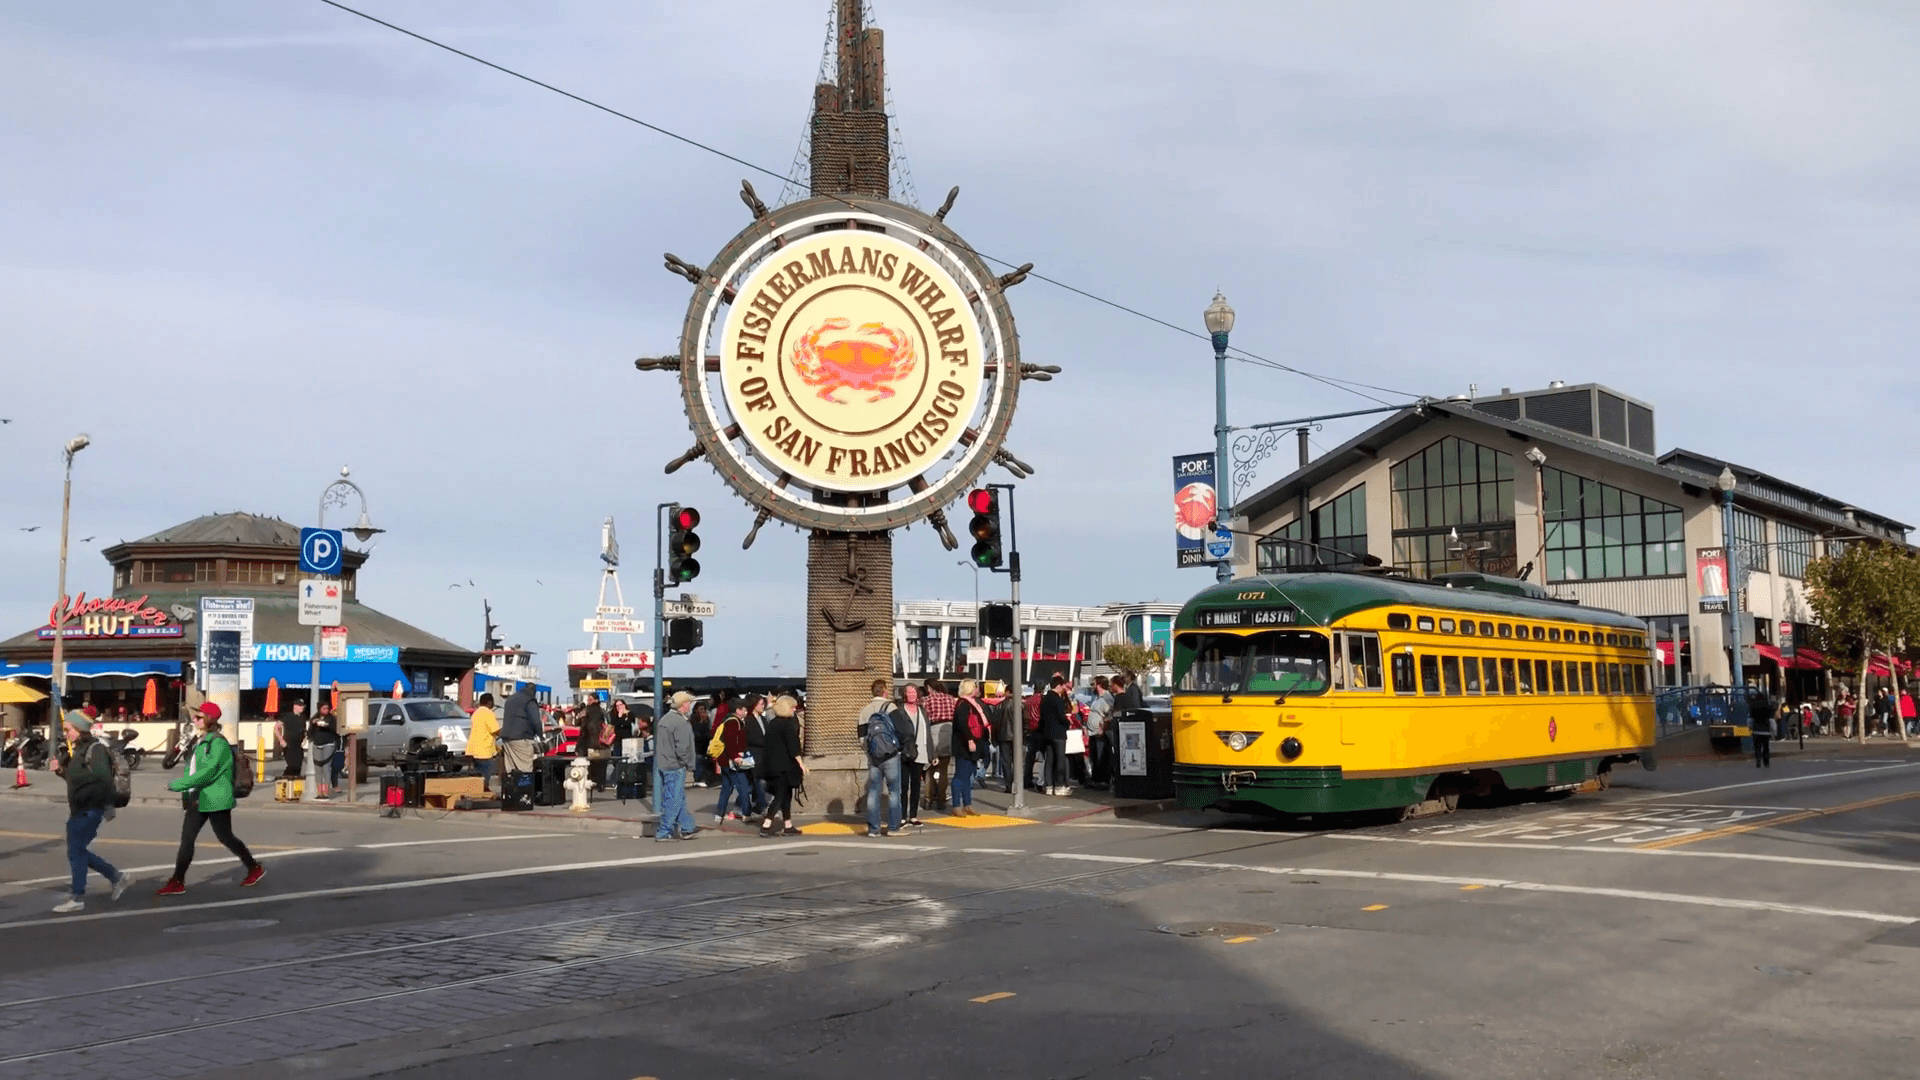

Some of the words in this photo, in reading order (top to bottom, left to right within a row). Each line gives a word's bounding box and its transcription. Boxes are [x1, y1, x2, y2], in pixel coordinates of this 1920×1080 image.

[736, 246, 899, 363] FISHERMANS
[898, 261, 969, 368] WHARF
[739, 375, 777, 413] OF
[763, 415, 823, 468] SAN
[825, 379, 966, 478] FRANCISCO
[1181, 460, 1208, 473] PORT
[313, 539, 332, 563] P
[1182, 553, 1204, 564] DININ
[1237, 591, 1266, 600] 1071
[50, 592, 167, 628] Chowder
[304, 602, 338, 611] Fisherman's
[669, 602, 712, 613] Jefferson
[1704, 603, 1724, 611] TRAVEL
[84, 615, 134, 635] HUT
[1206, 613, 1212, 625] F
[1214, 612, 1241, 625] MARKET
[265, 644, 311, 661] HOUR
